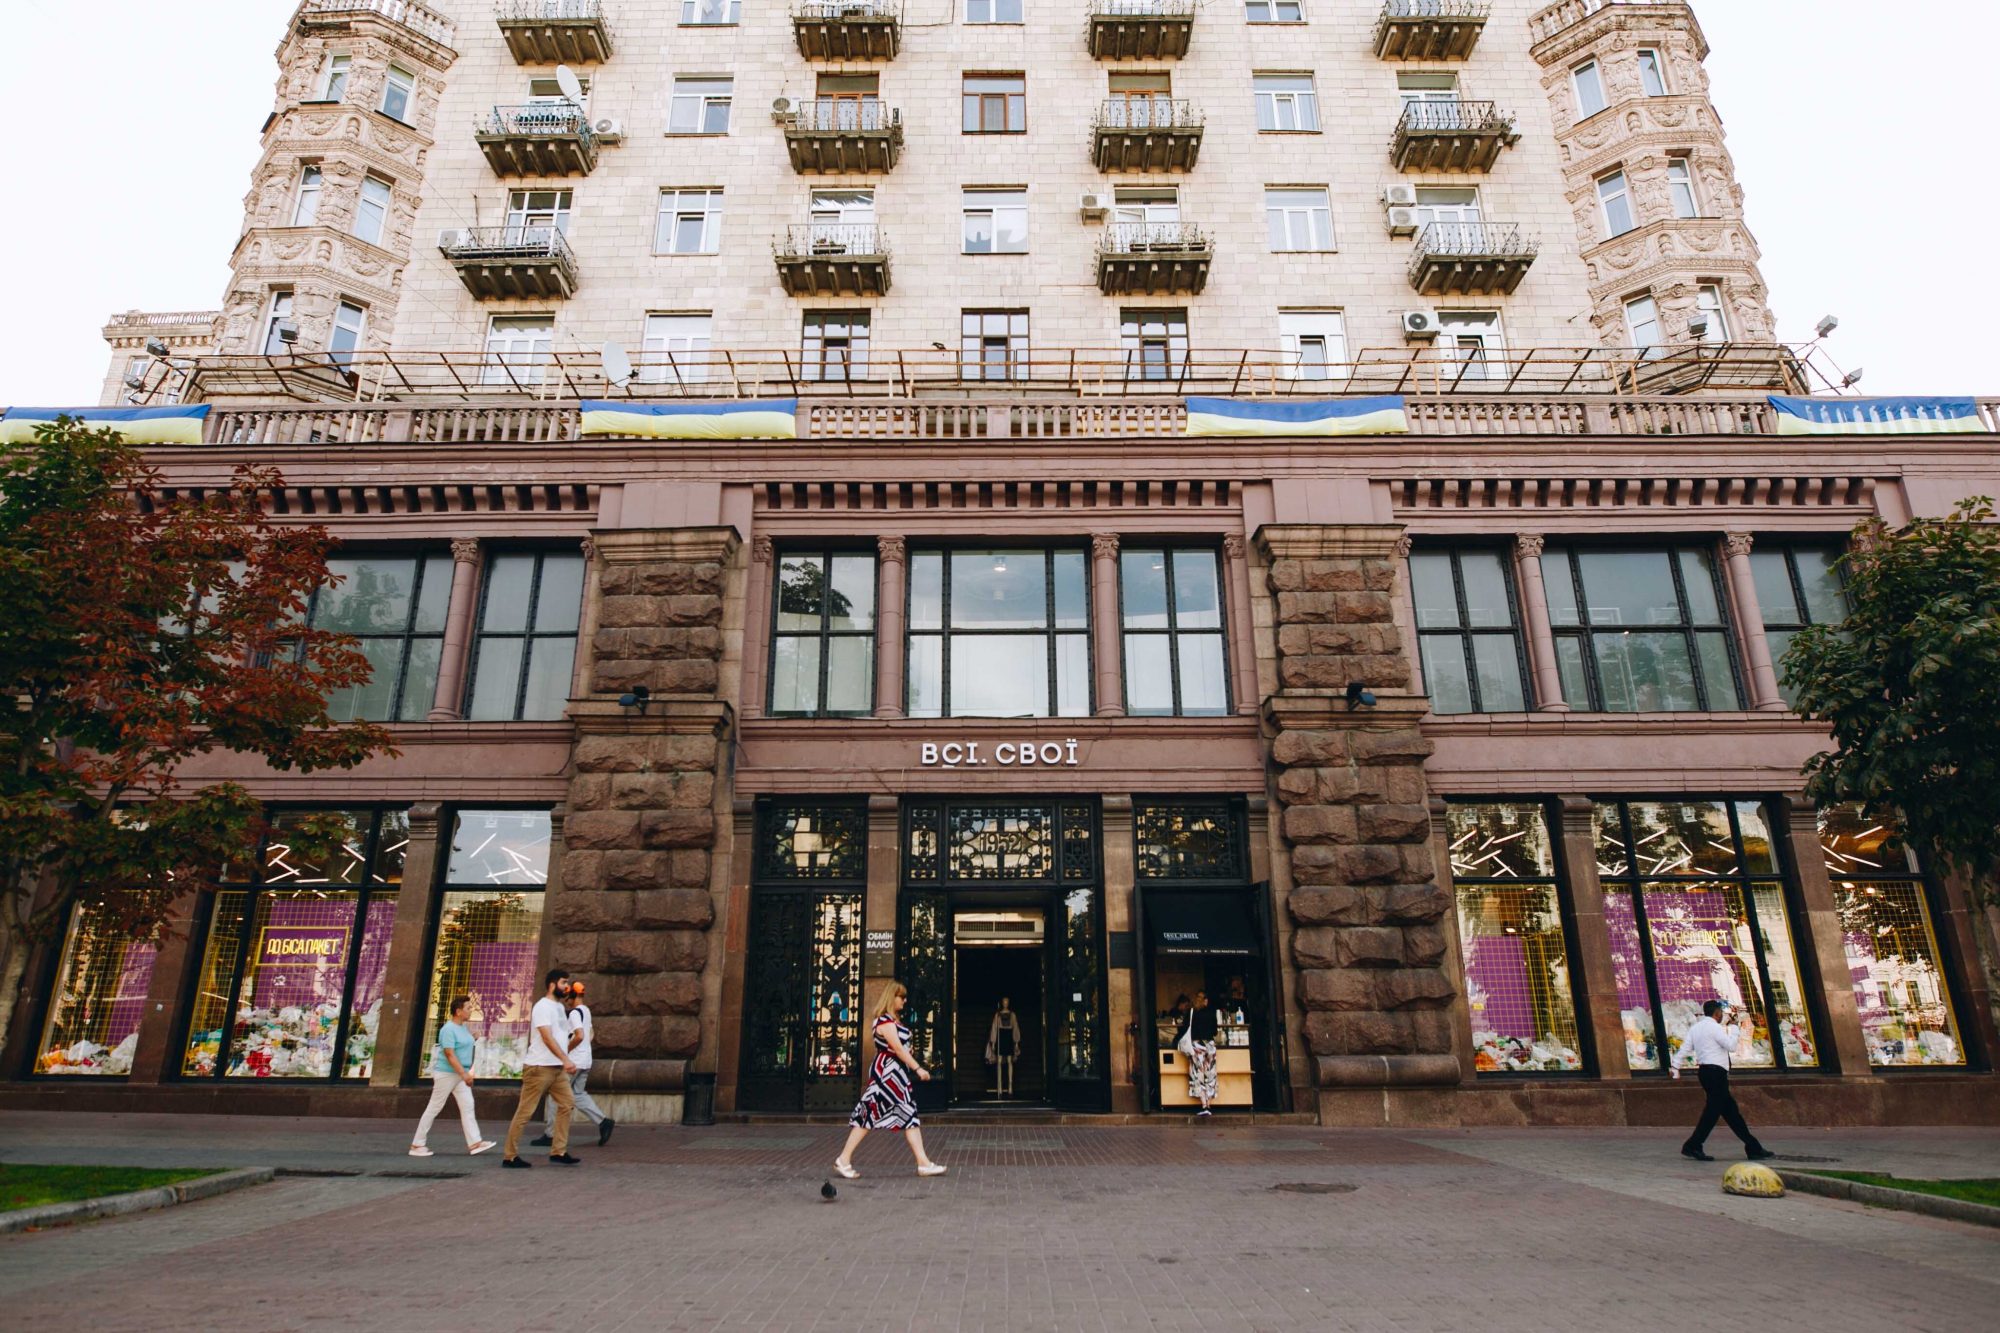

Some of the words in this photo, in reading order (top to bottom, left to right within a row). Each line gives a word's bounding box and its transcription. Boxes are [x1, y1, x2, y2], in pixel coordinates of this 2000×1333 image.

[921, 742, 987, 765] ВСІ.
[995, 738, 1078, 765] СВОЇ
[980, 833, 1021, 854] 1952
[266, 938, 281, 955] ДО
[282, 938, 304, 955] БІСА
[304, 938, 340, 955] ПАКЕТ
[866, 941, 894, 949] ВАЛЮТ
